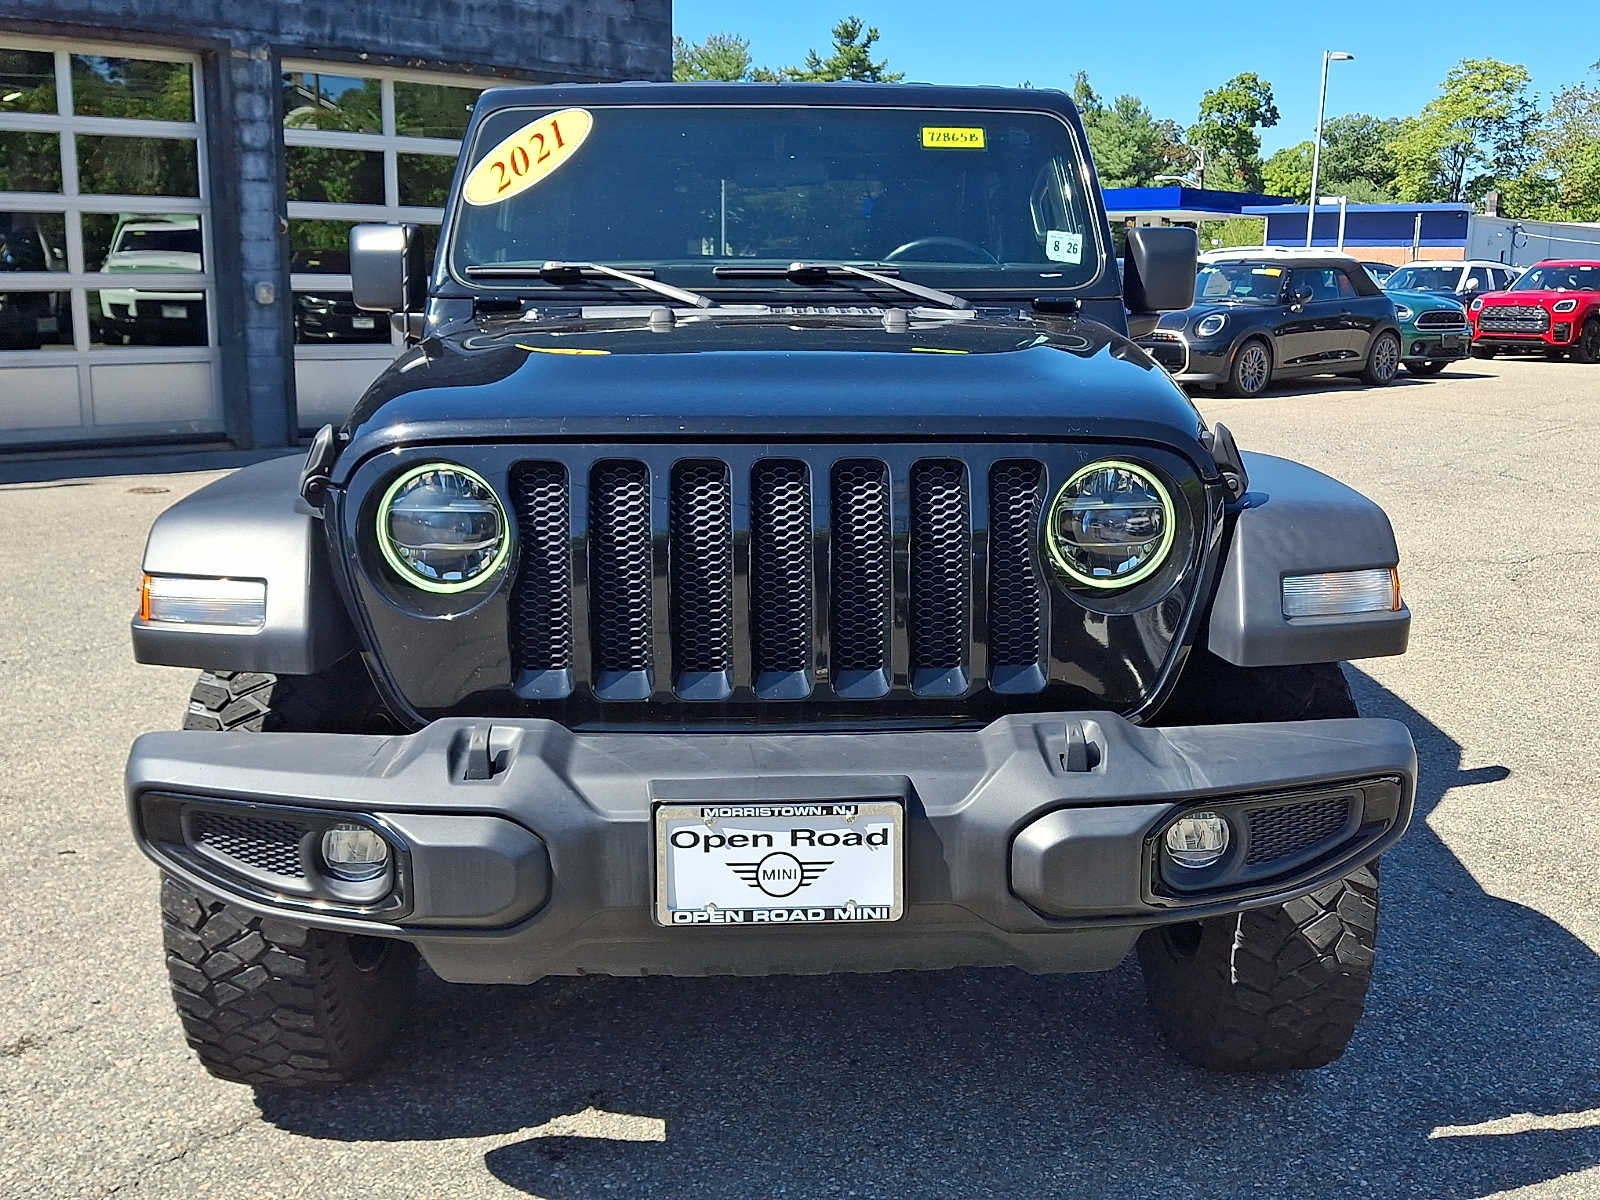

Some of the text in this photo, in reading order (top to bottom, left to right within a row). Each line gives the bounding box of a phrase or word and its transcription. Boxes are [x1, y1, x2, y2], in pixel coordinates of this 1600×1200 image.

[490, 120, 565, 192] 2021
[1053, 240, 1078, 254] 8 26
[832, 805, 856, 815] NJ
[670, 828, 889, 853] Open Road
[762, 869, 797, 881] MINI
[673, 908, 888, 923] OPEN ROAD MINI
